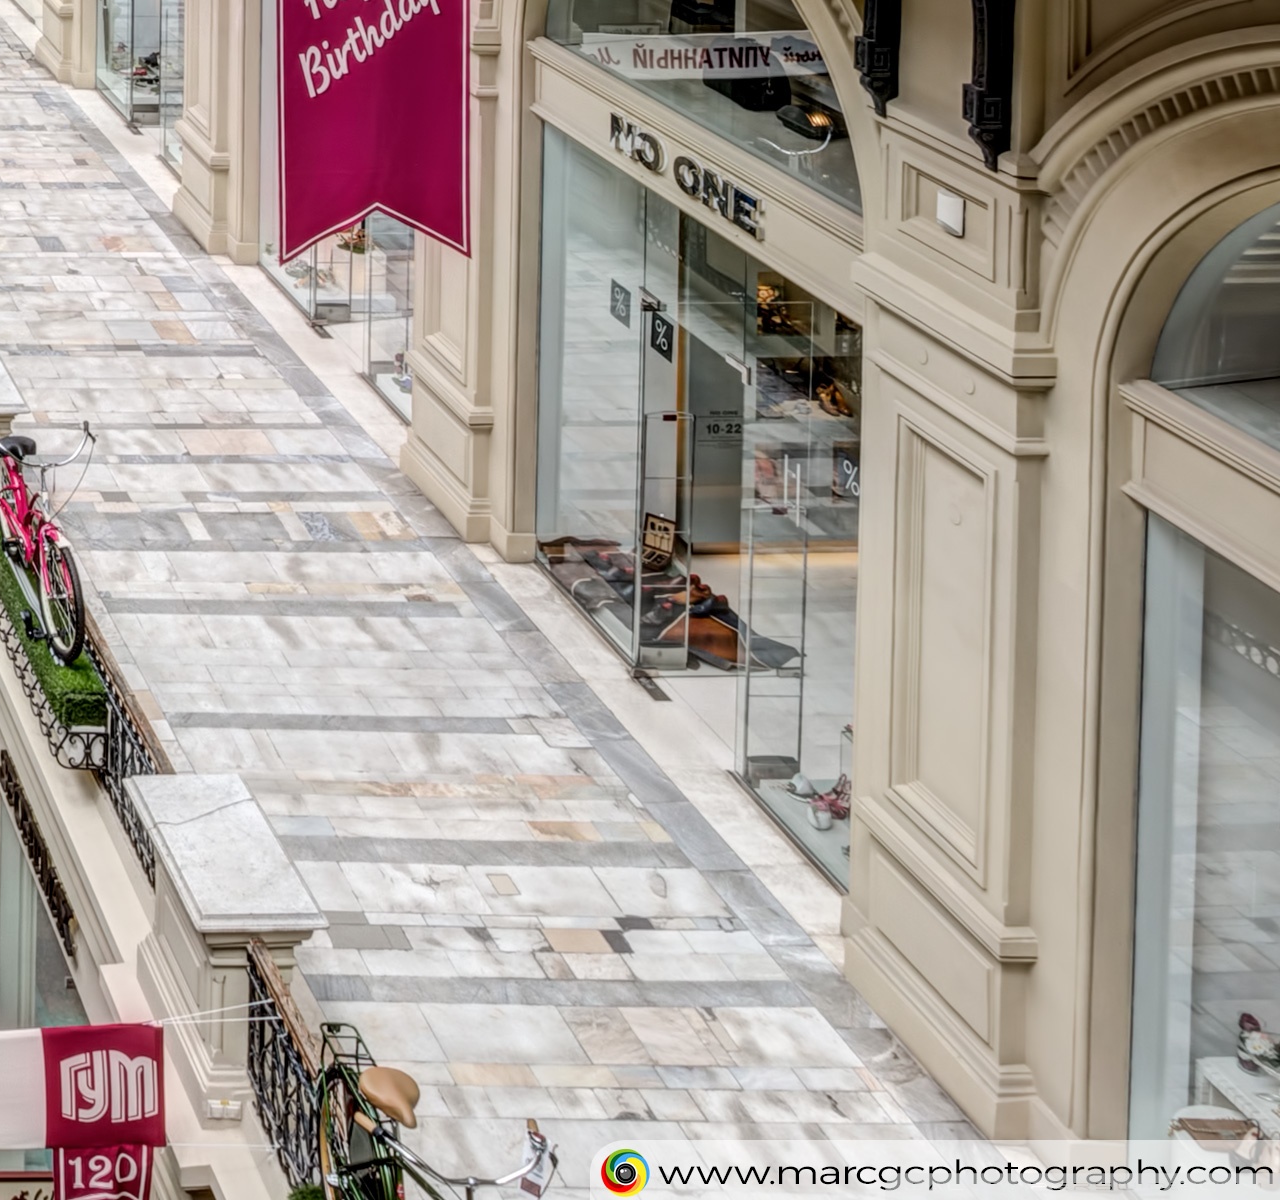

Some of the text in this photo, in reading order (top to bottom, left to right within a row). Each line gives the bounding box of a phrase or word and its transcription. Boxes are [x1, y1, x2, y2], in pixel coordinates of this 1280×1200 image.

[609, 112, 766, 242] NO ONE
[706, 423, 742, 435] 10-22
[59, 1048, 159, 1125] ГУМ
[67, 1152, 138, 1190] 120
